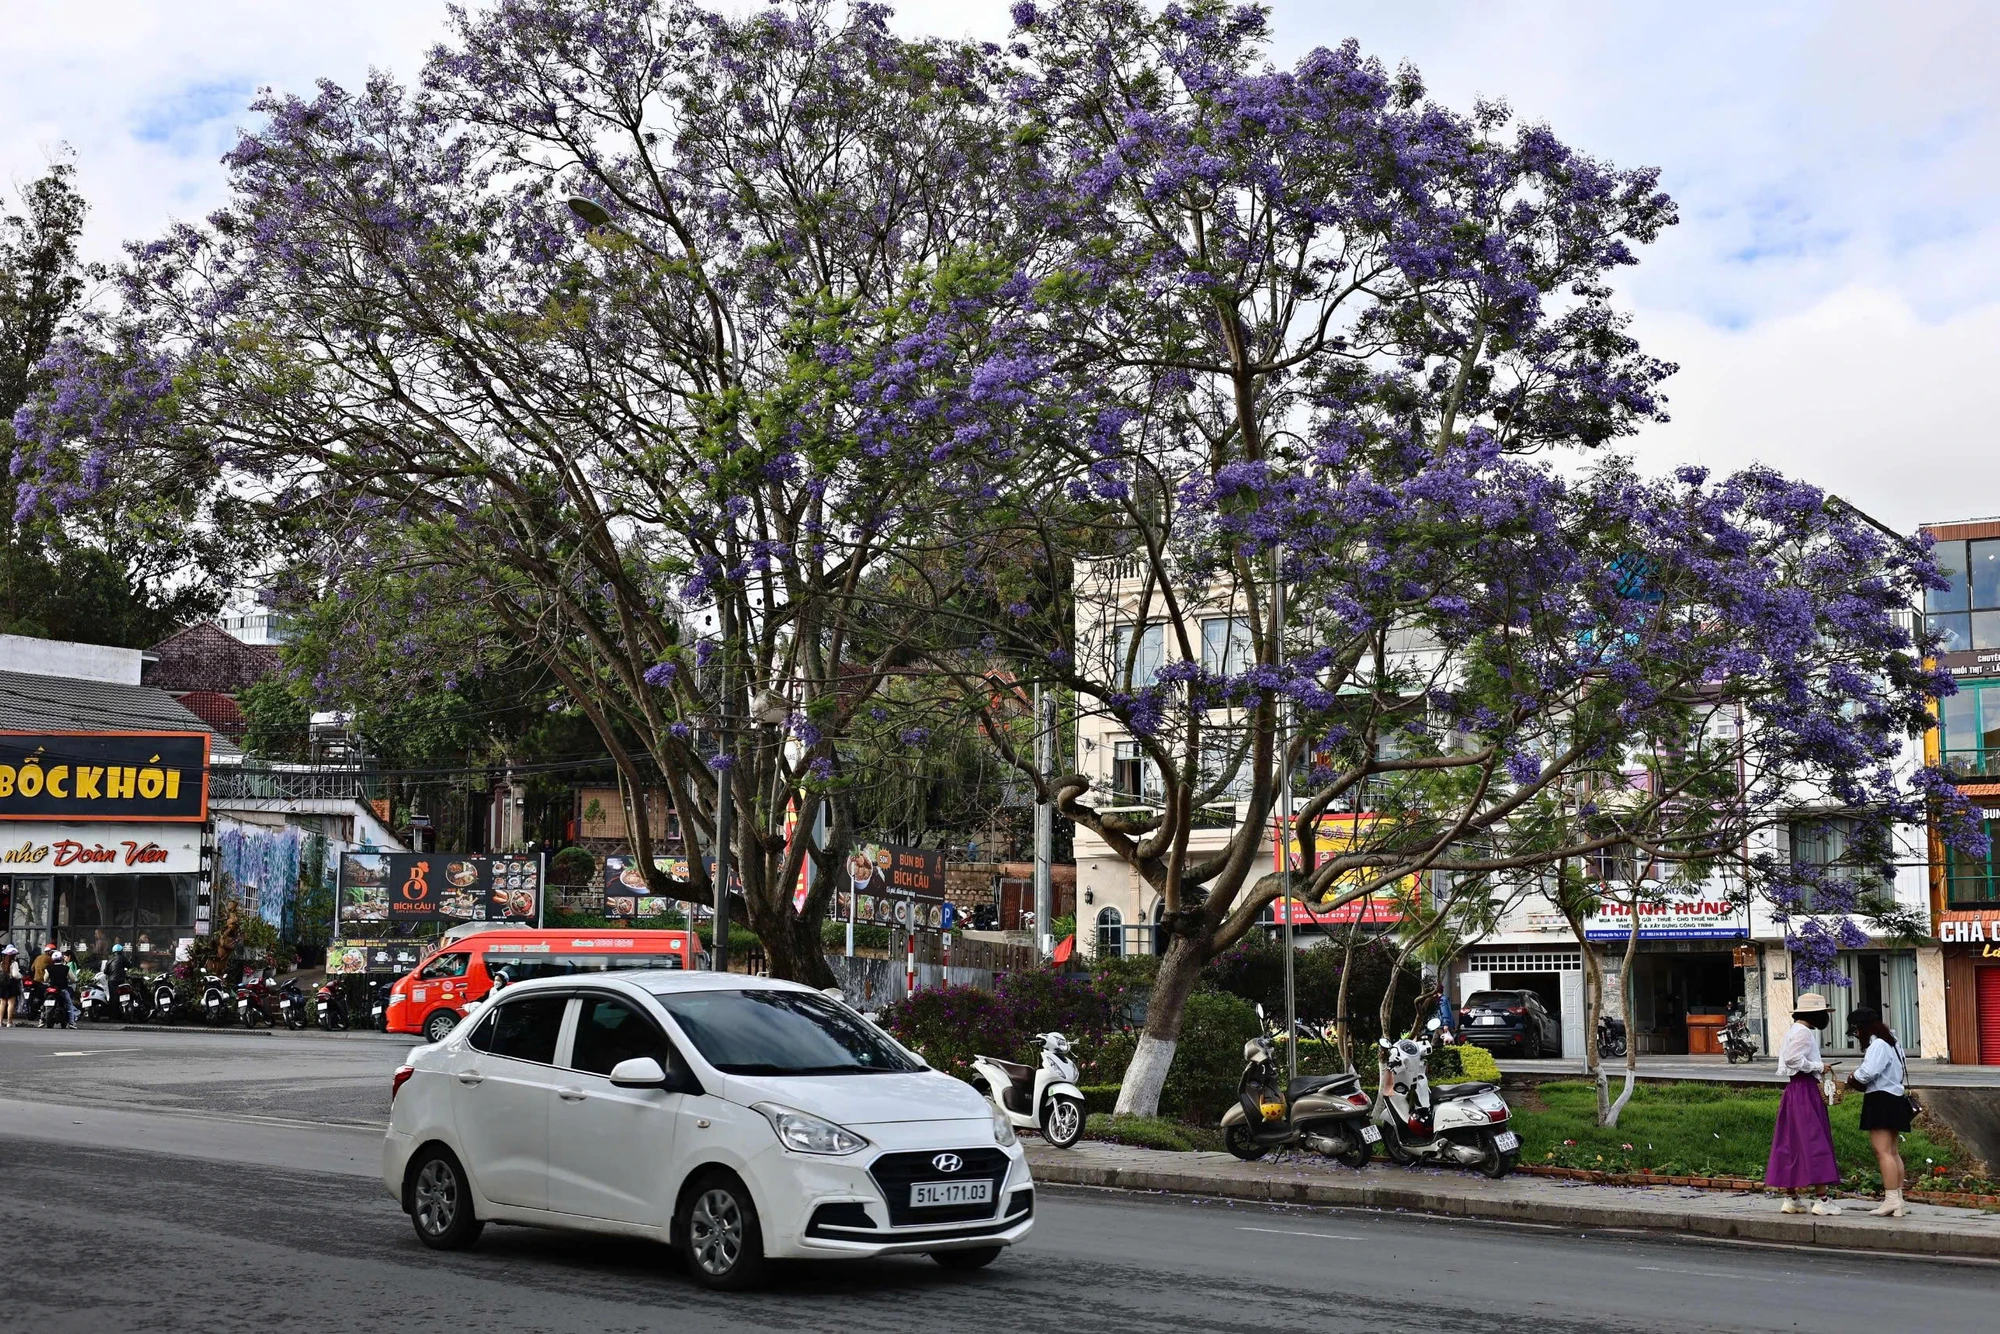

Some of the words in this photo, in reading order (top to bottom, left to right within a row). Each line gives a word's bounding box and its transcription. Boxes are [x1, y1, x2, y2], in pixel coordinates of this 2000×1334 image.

[1978, 653, 2000, 662] CHUYÊ
[76, 754, 181, 800] KHÓI
[52, 839, 117, 867] Đoàn
[120, 841, 168, 866] Viên
[900, 852, 914, 867] BÚN
[915, 854, 925, 869] BÒ
[894, 868, 912, 886] BÍCH
[393, 901, 413, 910] BÍCH
[1675, 899, 1734, 915] HƯNG
[944, 907, 951, 923] P
[1940, 914, 1985, 943] CHẢ
[917, 1184, 986, 1203] 51L-171.03
